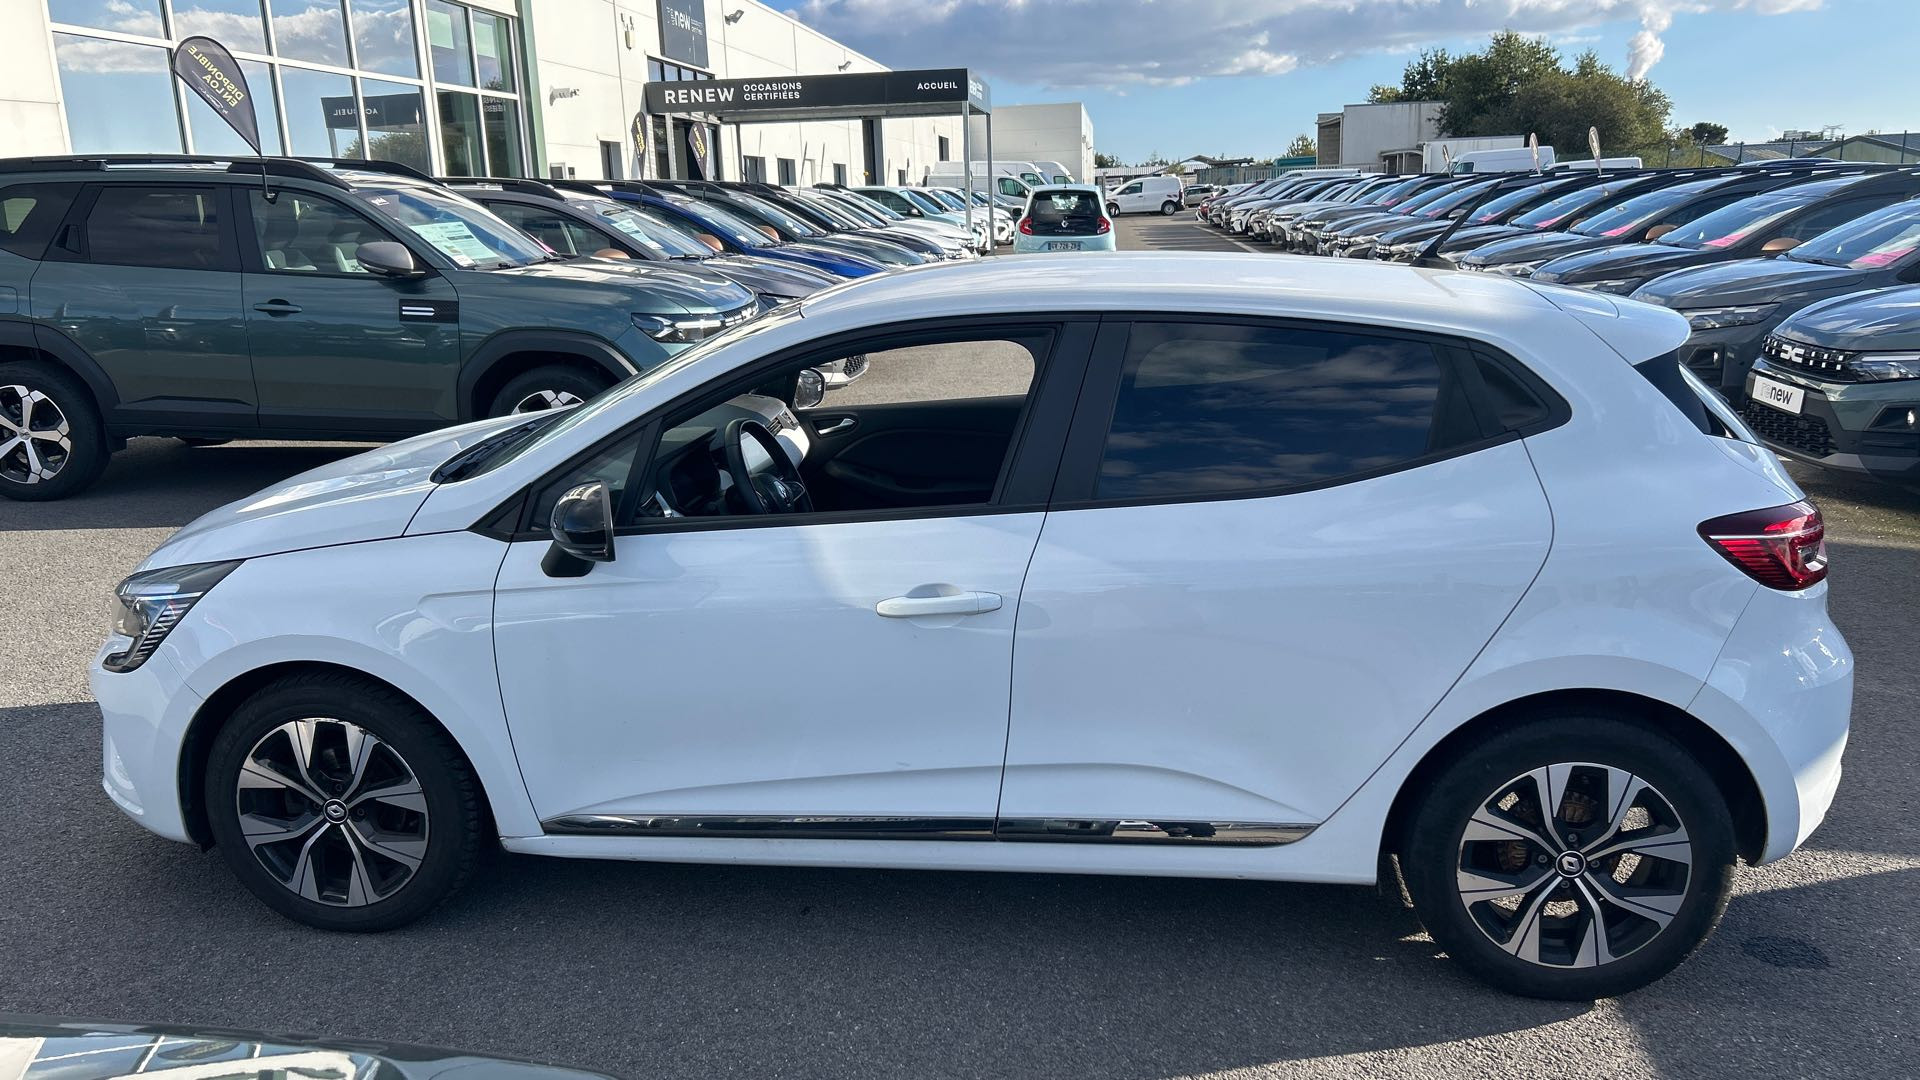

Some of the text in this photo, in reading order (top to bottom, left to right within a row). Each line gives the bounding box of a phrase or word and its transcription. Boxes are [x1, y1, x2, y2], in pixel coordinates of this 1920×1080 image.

[743, 82, 802, 92] OCCASIONS
[917, 81, 958, 90] ACCUEIL
[664, 87, 735, 104] RENEW
[743, 91, 801, 101] CERTIFIÉES
